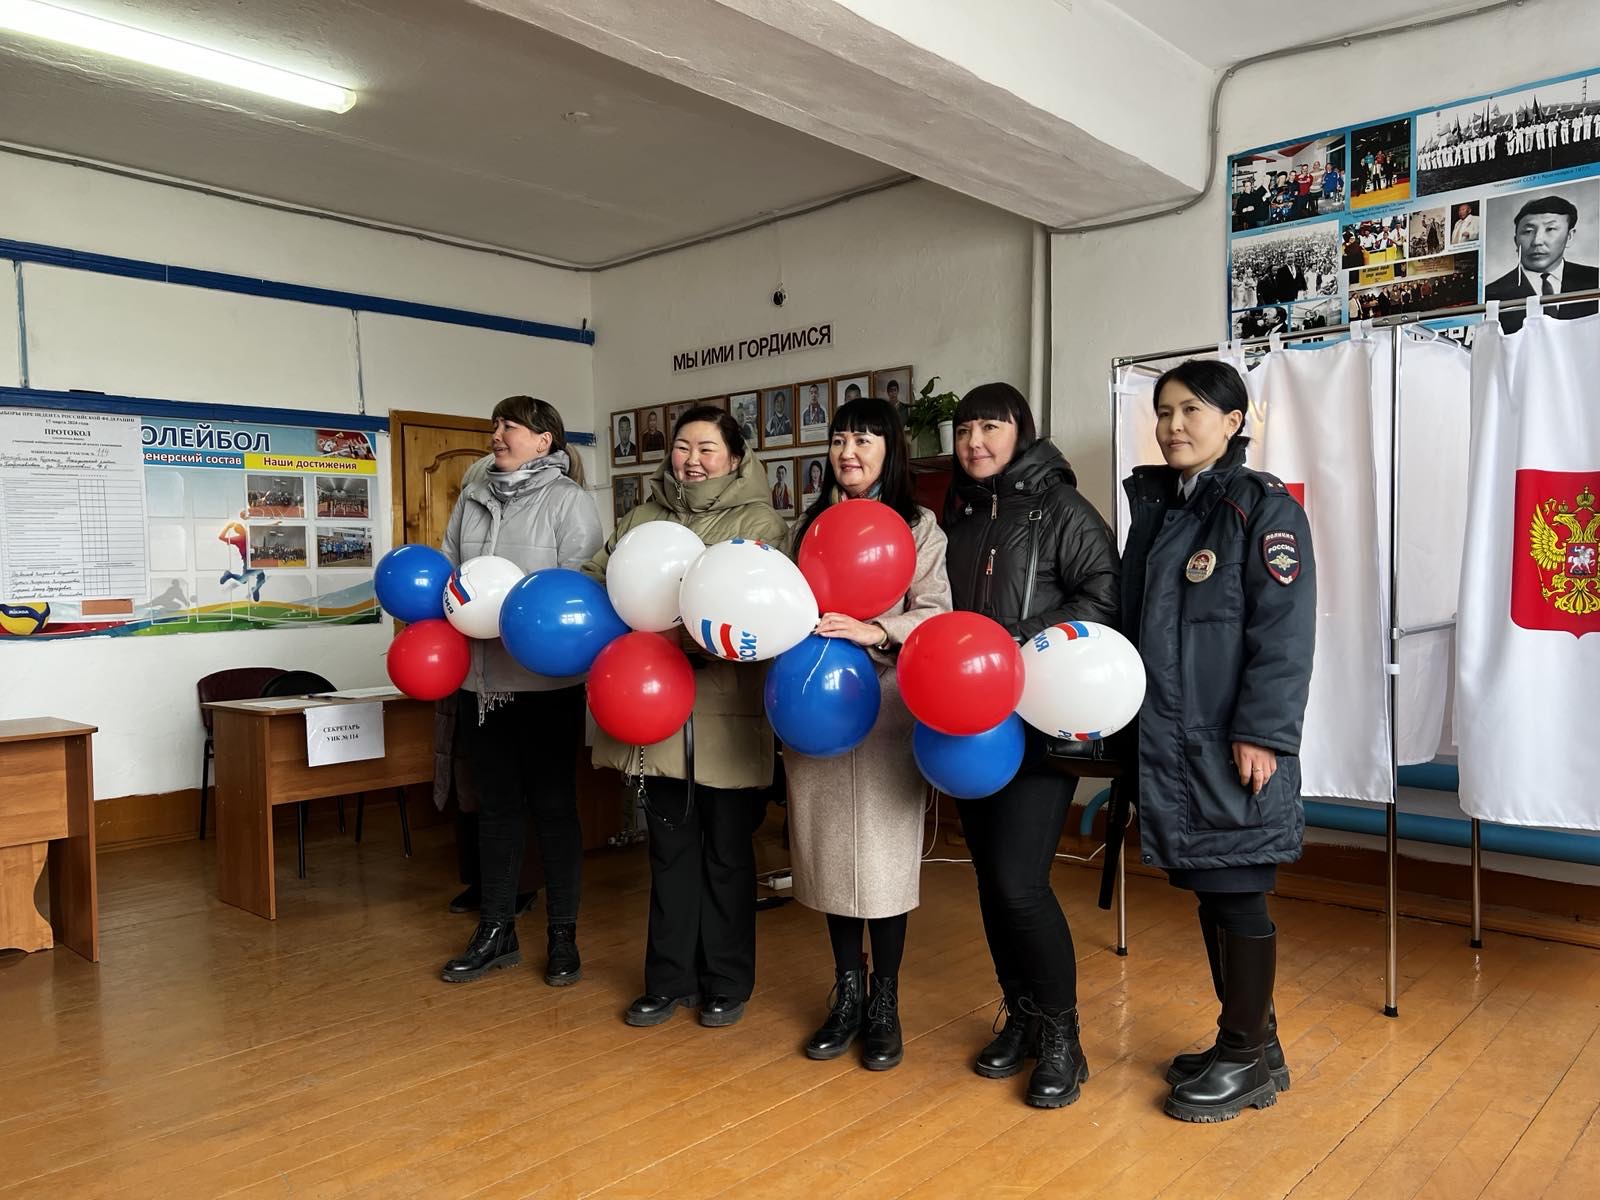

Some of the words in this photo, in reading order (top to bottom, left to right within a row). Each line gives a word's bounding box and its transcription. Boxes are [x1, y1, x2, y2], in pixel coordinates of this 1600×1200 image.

[673, 351, 698, 371] МЫ
[702, 344, 734, 366] ИМИ
[739, 324, 831, 360] ГОРДИМСЯ
[44, 428, 91, 437] ПРОТОКОЛ
[141, 423, 270, 452] ОЛЕЙБОЛ
[143, 453, 203, 464] енерский
[206, 456, 242, 465] состав
[264, 457, 293, 468] Наши
[296, 460, 357, 470] достижения
[1268, 544, 1295, 554] РОССИЯ
[323, 724, 360, 733] СЕКРЕТАРЬ
